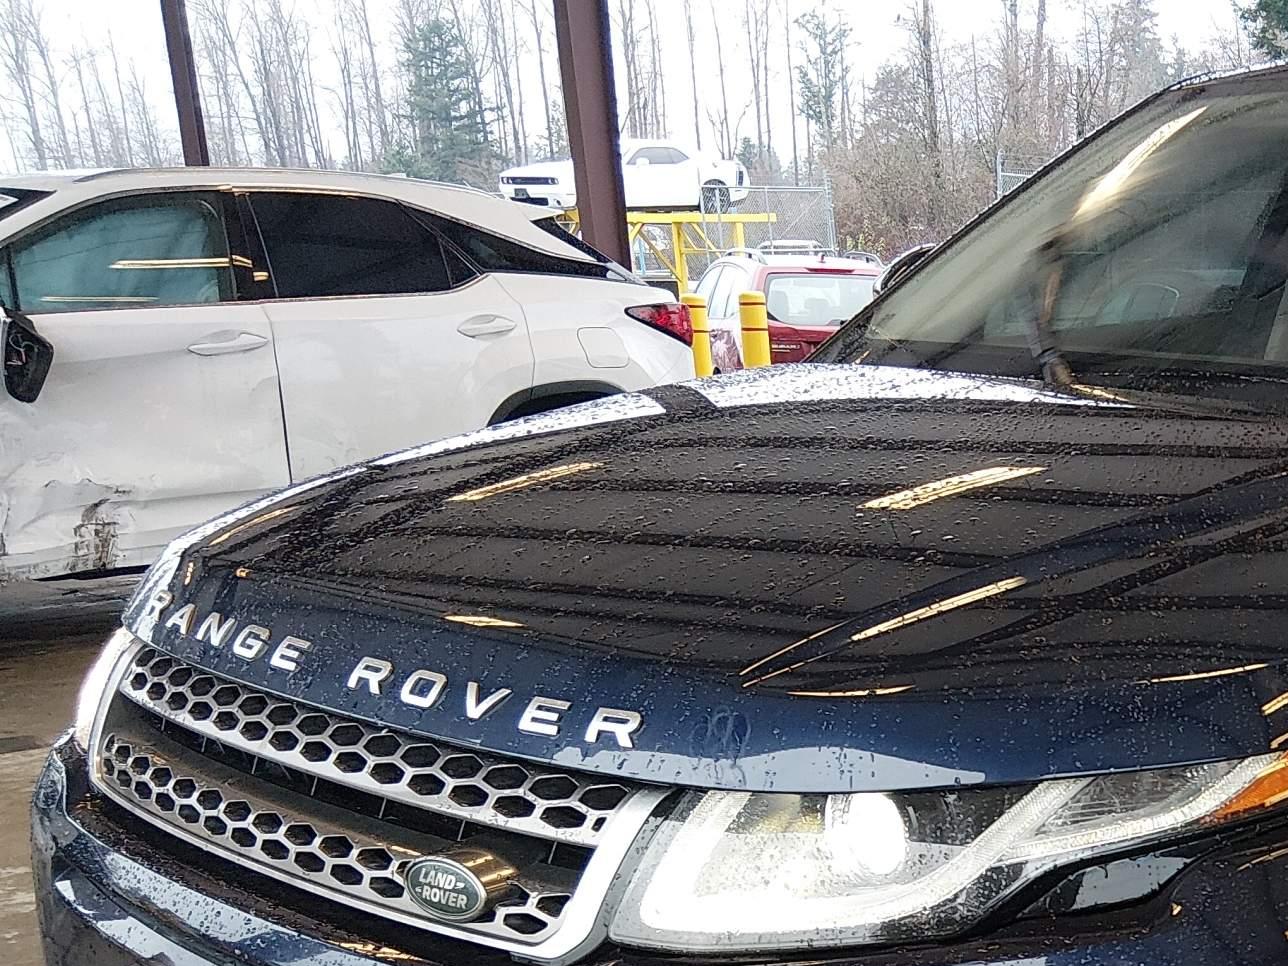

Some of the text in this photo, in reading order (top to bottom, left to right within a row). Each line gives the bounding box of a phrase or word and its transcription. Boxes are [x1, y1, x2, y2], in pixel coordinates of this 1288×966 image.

[147, 589, 643, 749] RANGE ROVER
[418, 867, 457, 890] LAND
[421, 884, 468, 910] ROVER
